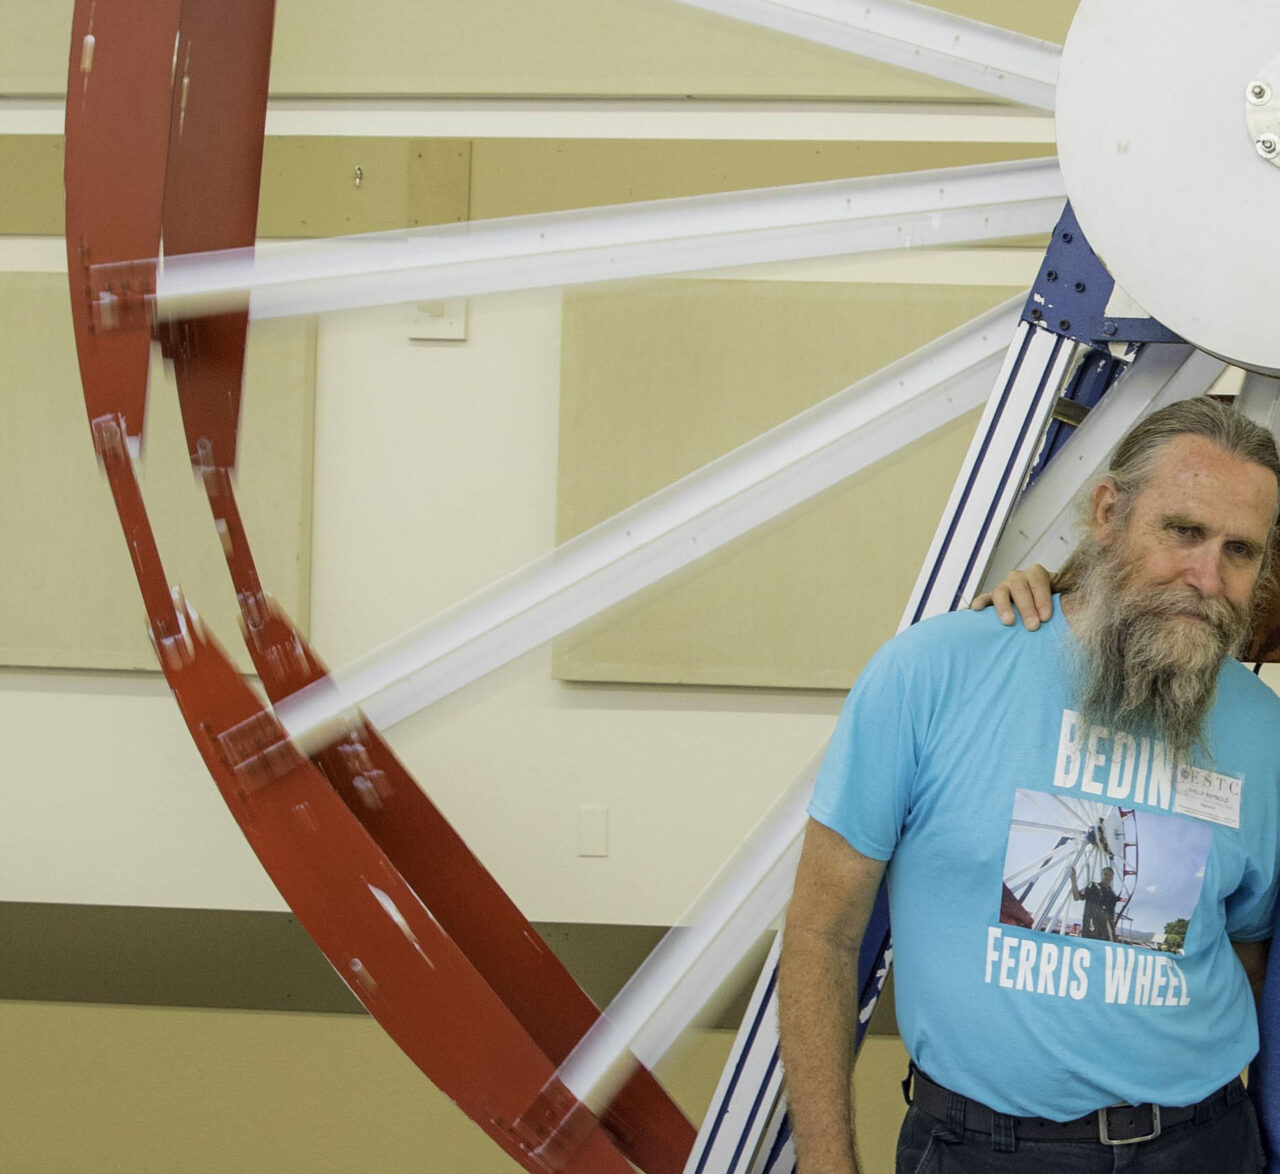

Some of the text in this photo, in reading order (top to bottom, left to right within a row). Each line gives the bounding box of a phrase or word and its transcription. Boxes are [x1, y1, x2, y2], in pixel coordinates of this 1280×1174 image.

[1053, 709, 1175, 811] BEDIN
[985, 926, 1191, 1007] FERRIS WHEEL
